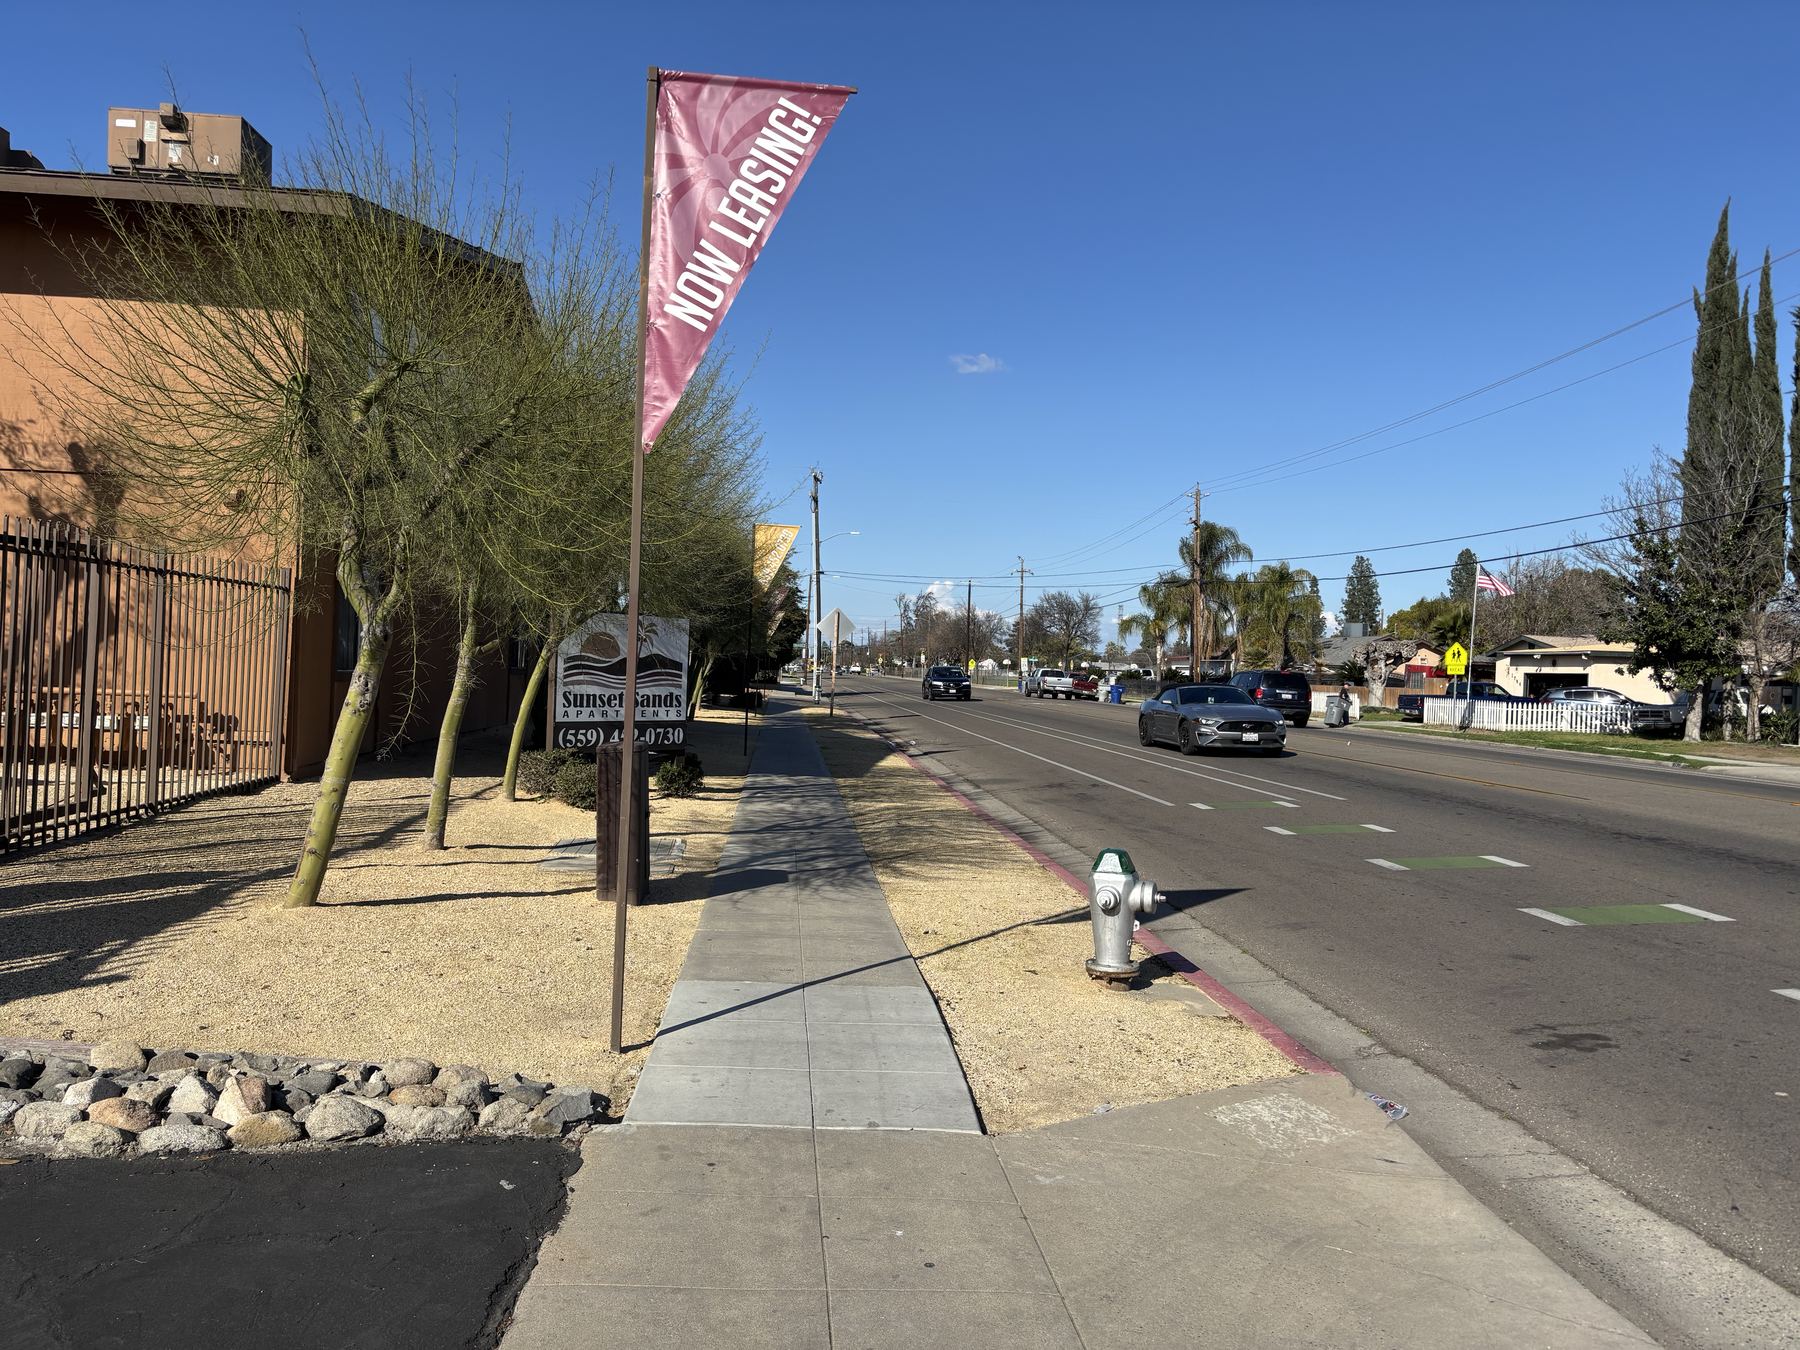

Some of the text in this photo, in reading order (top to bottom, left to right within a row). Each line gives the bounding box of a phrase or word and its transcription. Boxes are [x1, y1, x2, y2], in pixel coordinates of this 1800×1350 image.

[663, 96, 823, 333] NOW LEASING!
[562, 690, 625, 709] Sunset
[562, 709, 682, 719] APARTENTS
[558, 727, 605, 748] (559)
